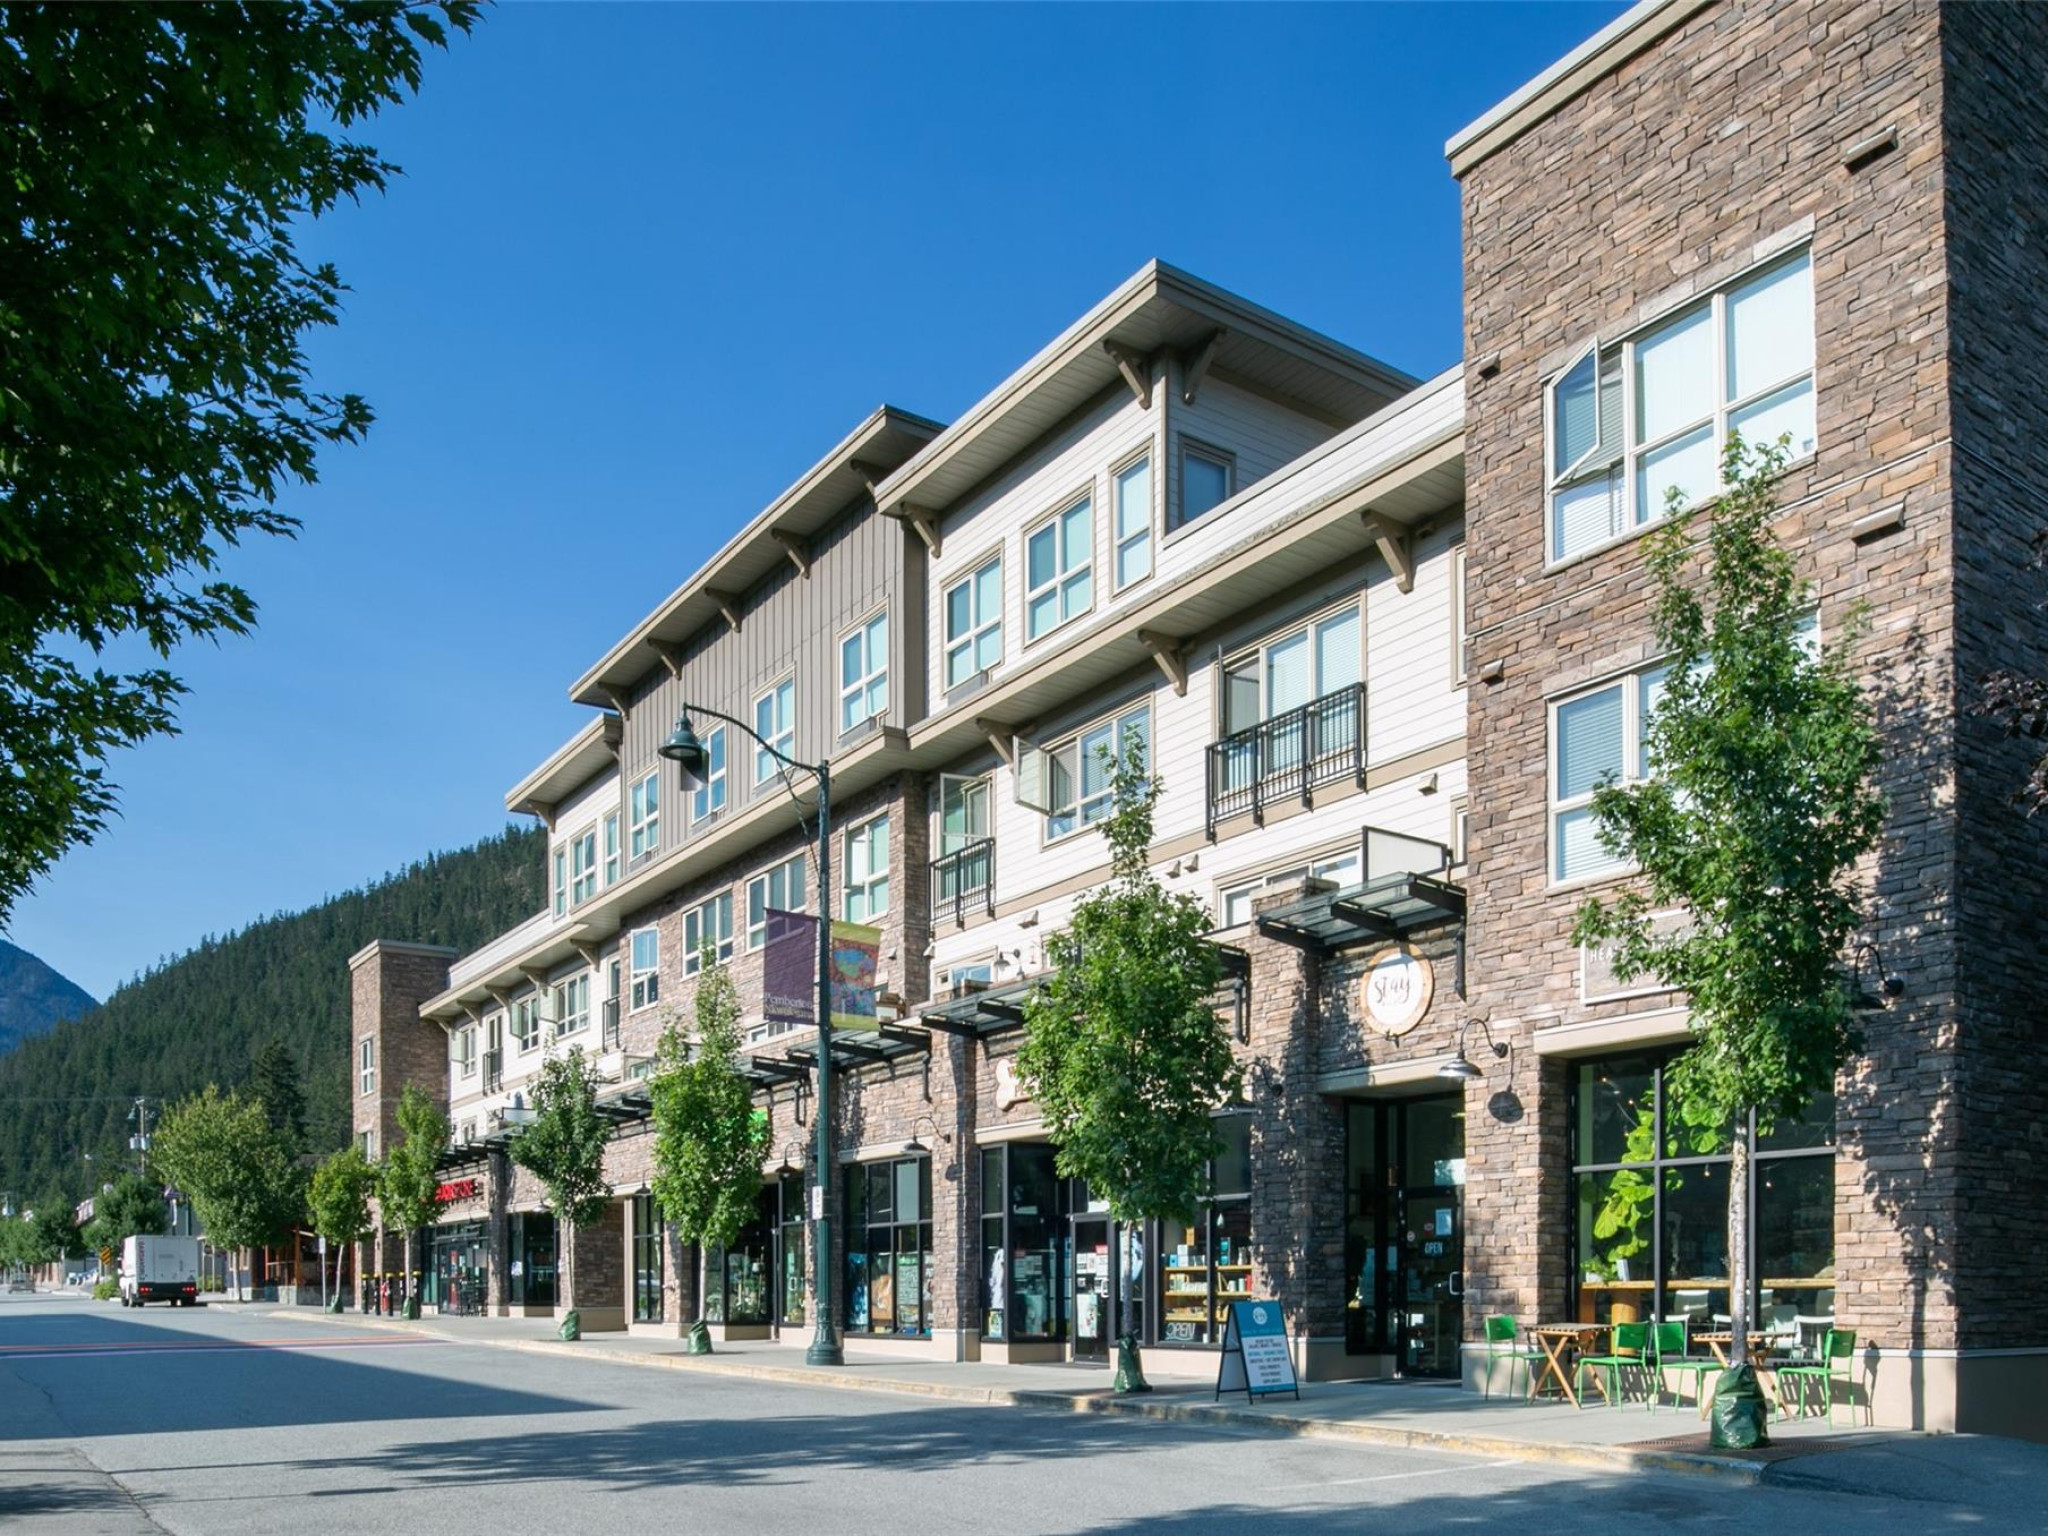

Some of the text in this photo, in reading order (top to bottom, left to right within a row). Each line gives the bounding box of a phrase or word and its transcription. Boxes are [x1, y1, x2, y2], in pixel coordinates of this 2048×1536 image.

[1374, 976, 1410, 1004] Stay
[1424, 1241, 1443, 1255] OPEN
[1165, 1322, 1196, 1340] OPEN
